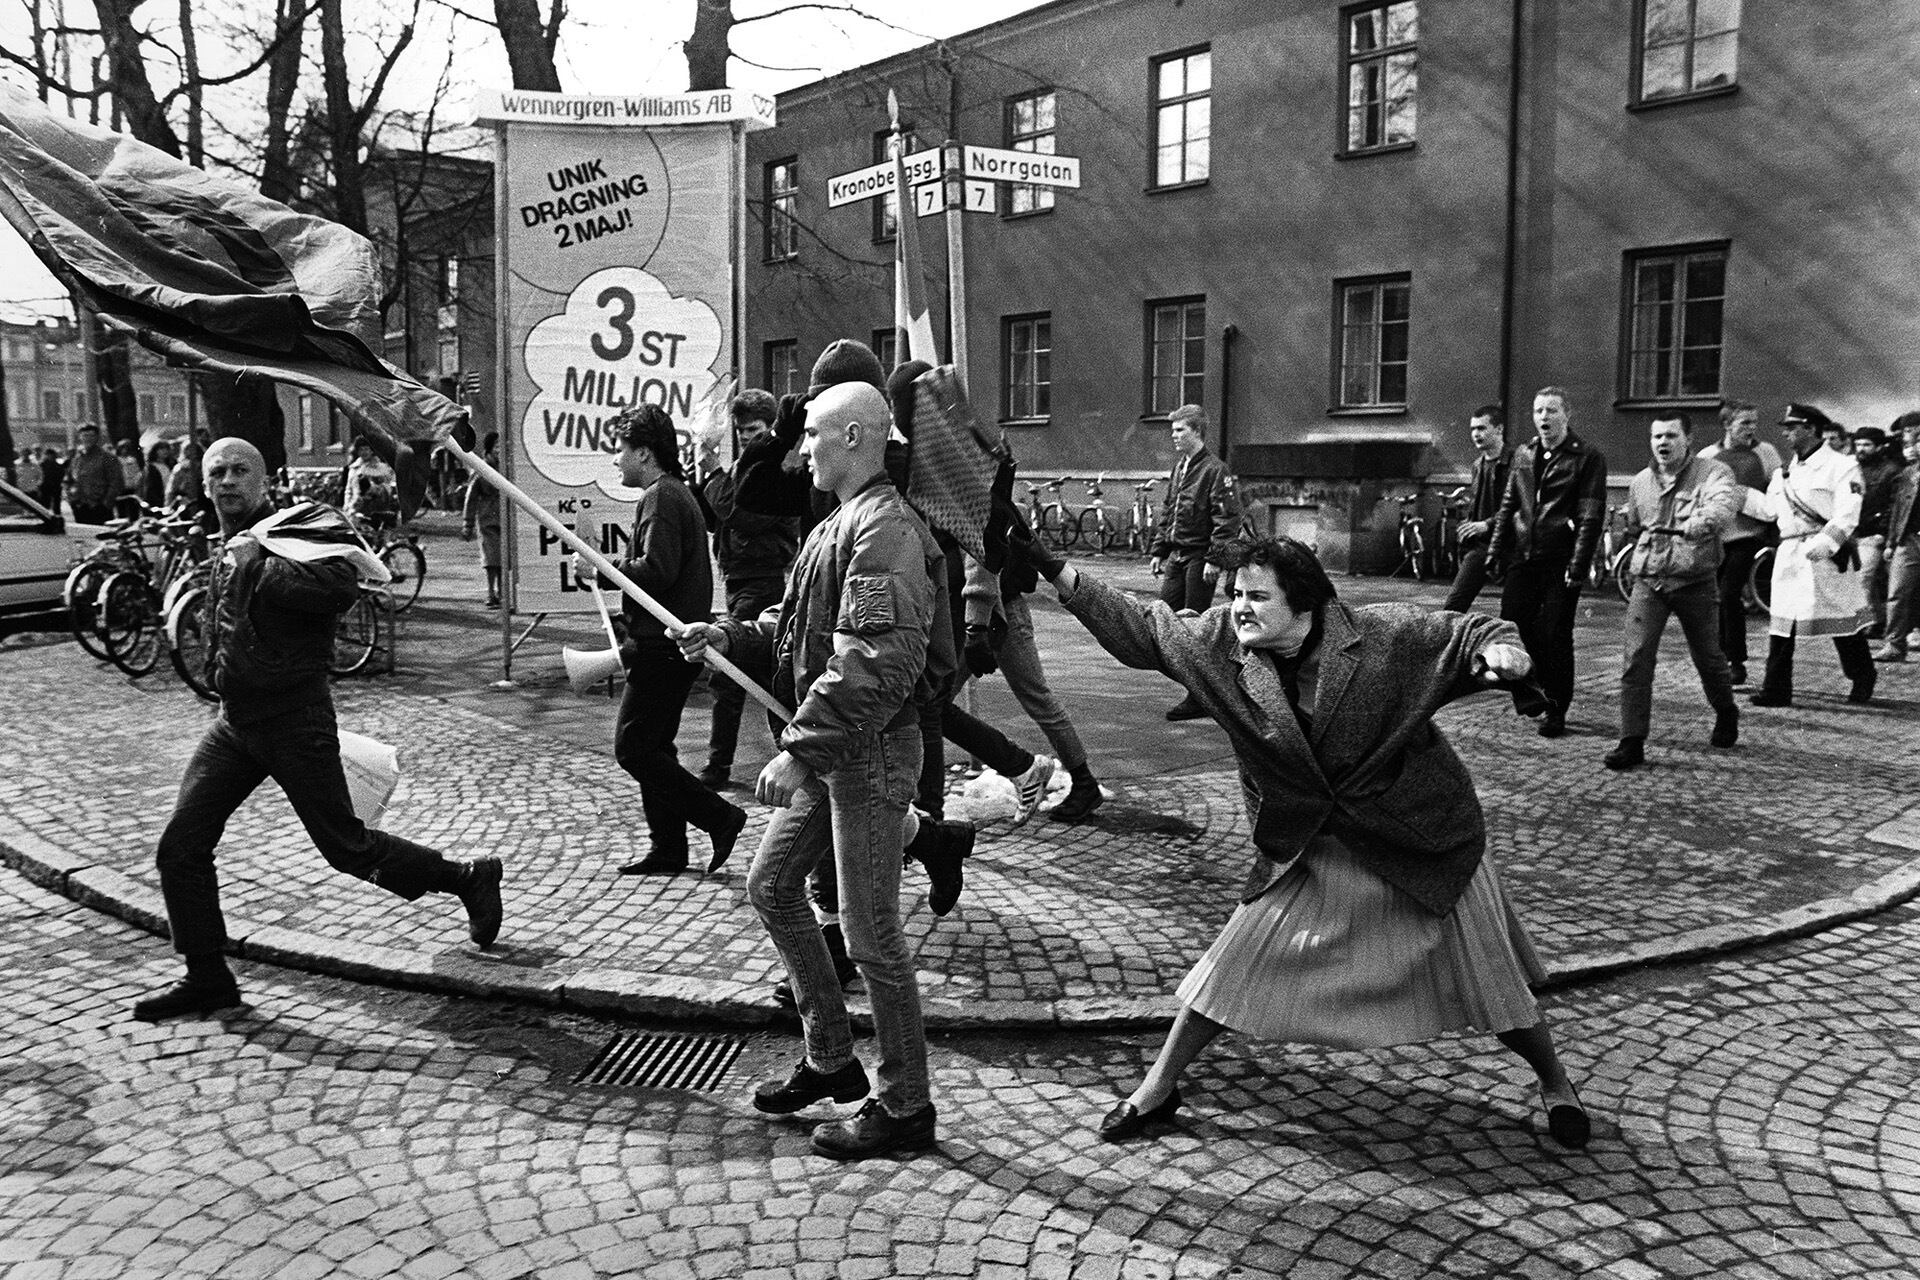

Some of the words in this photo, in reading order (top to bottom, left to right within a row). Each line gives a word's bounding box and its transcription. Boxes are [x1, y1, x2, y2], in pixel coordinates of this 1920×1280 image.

[501, 94, 701, 121] Wennergren-Williams
[706, 94, 732, 114] AB
[547, 158, 607, 192] UNIK
[832, 160, 937, 201] Kronobegsg.
[971, 152, 1072, 181] Norrgatan
[520, 174, 649, 228] DRAGNING
[924, 190, 935, 211] 7
[975, 188, 986, 206] 7
[554, 224, 574, 248] 2
[577, 207, 634, 244] MAJ!
[590, 286, 636, 362] 3
[639, 330, 687, 368] ST
[564, 366, 692, 418] MILJON
